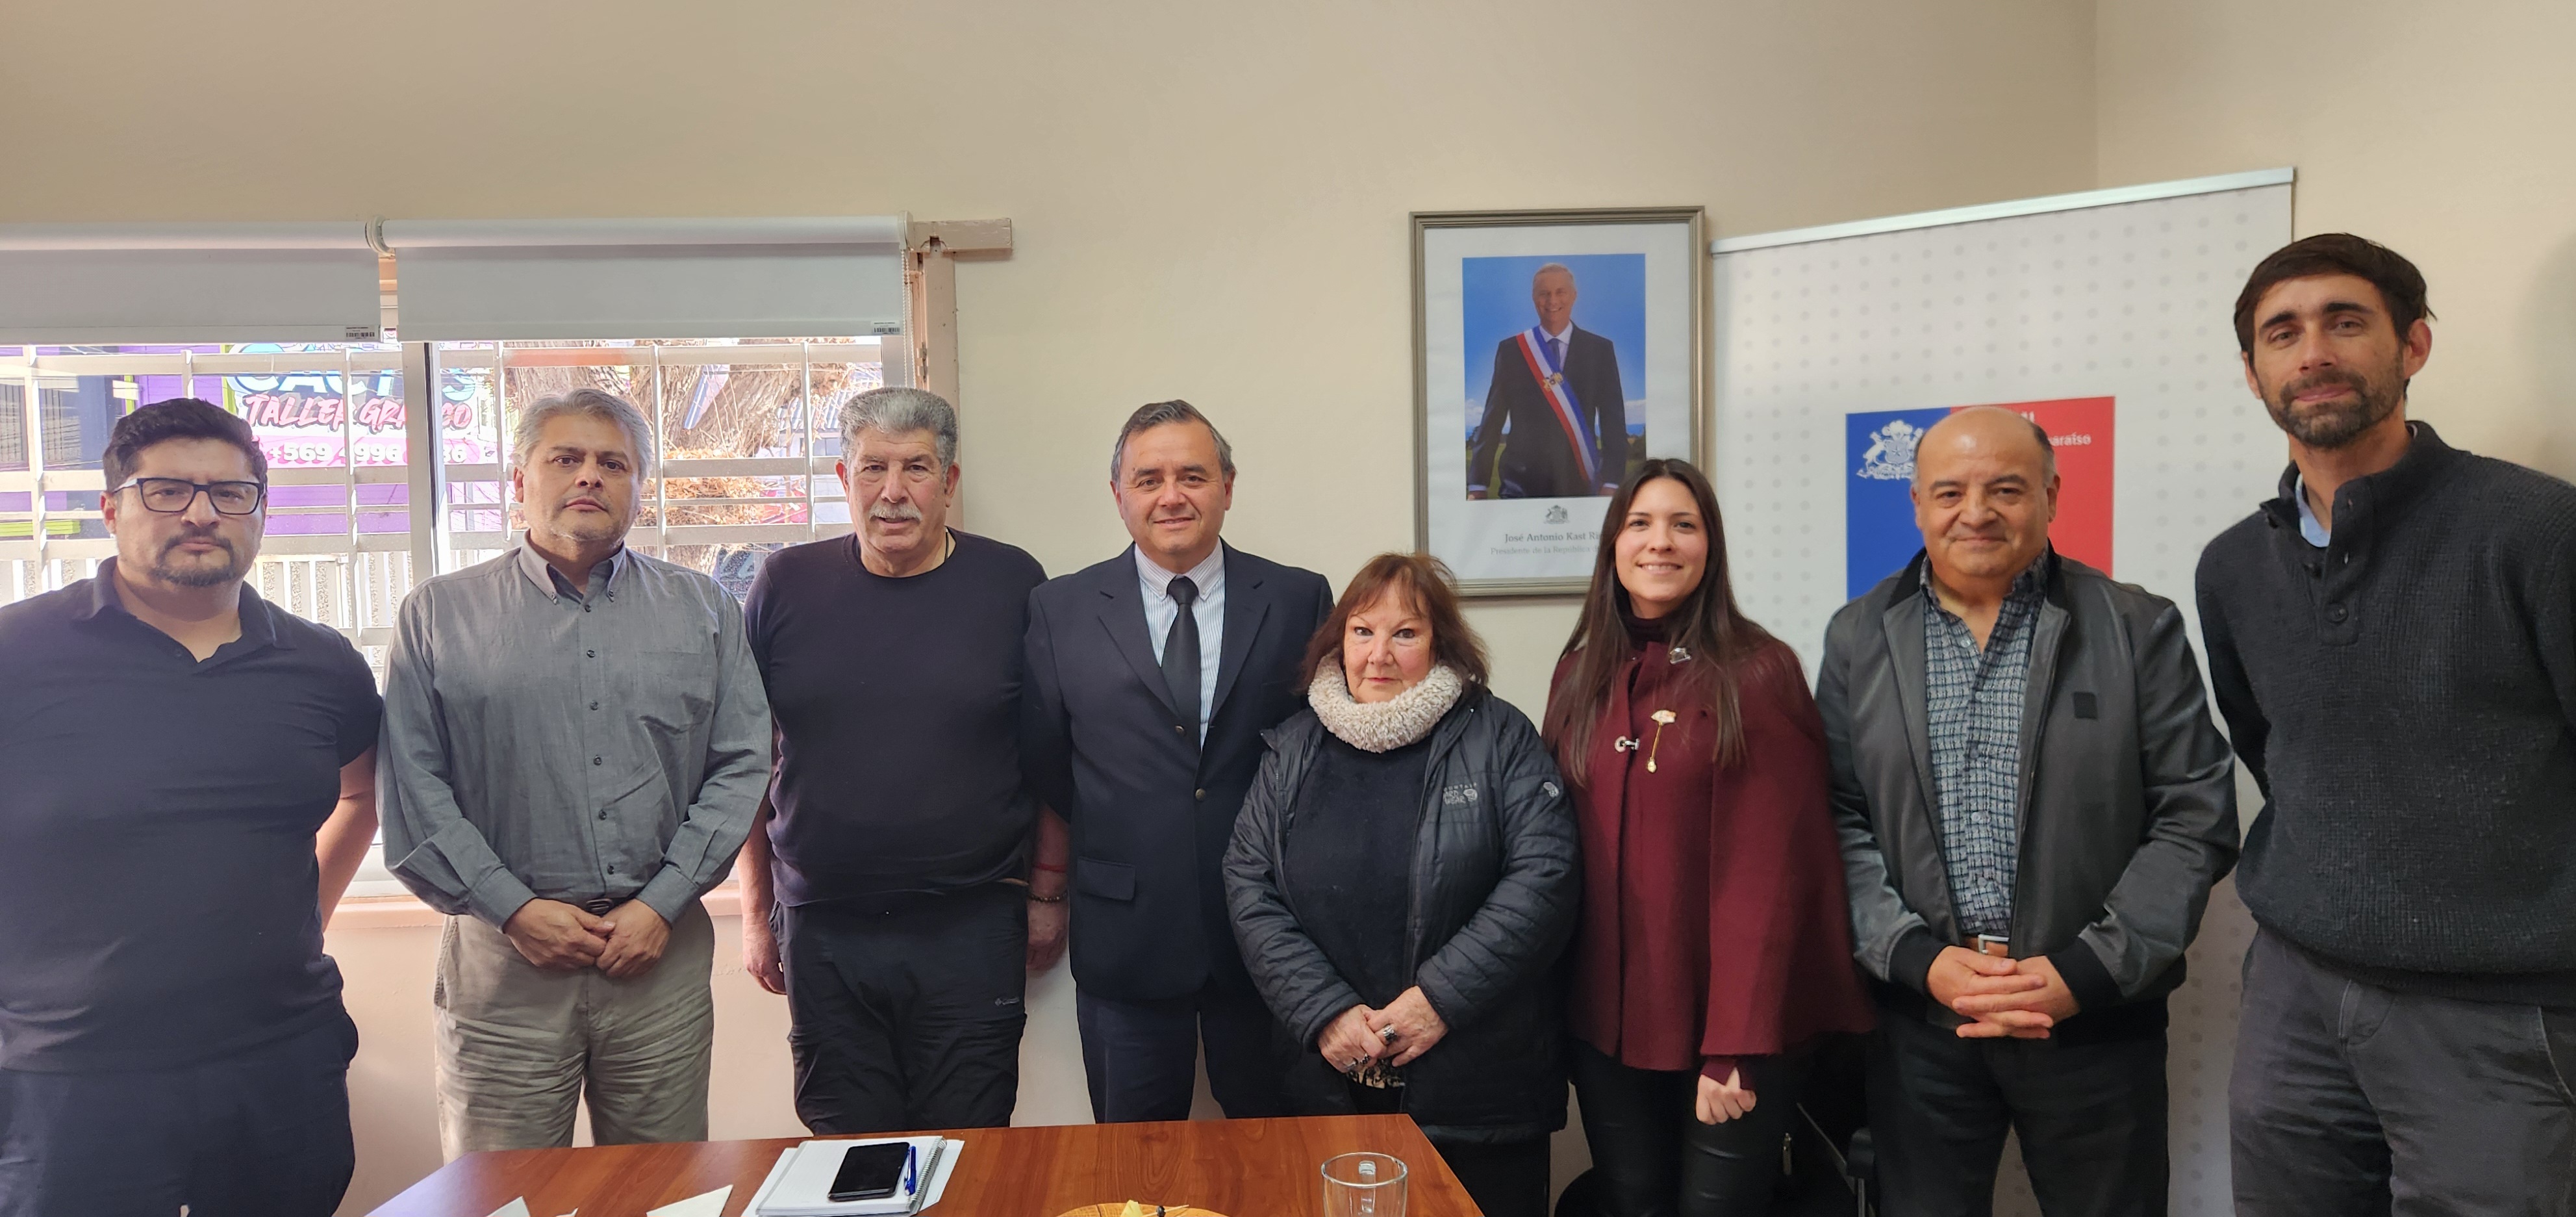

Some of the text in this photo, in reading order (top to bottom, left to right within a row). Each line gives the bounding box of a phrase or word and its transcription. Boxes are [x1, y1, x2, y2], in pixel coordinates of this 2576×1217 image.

[1505, 531, 1601, 543] José Antonio Kast Ri
[1491, 546, 1530, 555] Presidente
[1533, 546, 1540, 554] de
[1544, 546, 1551, 554] la
